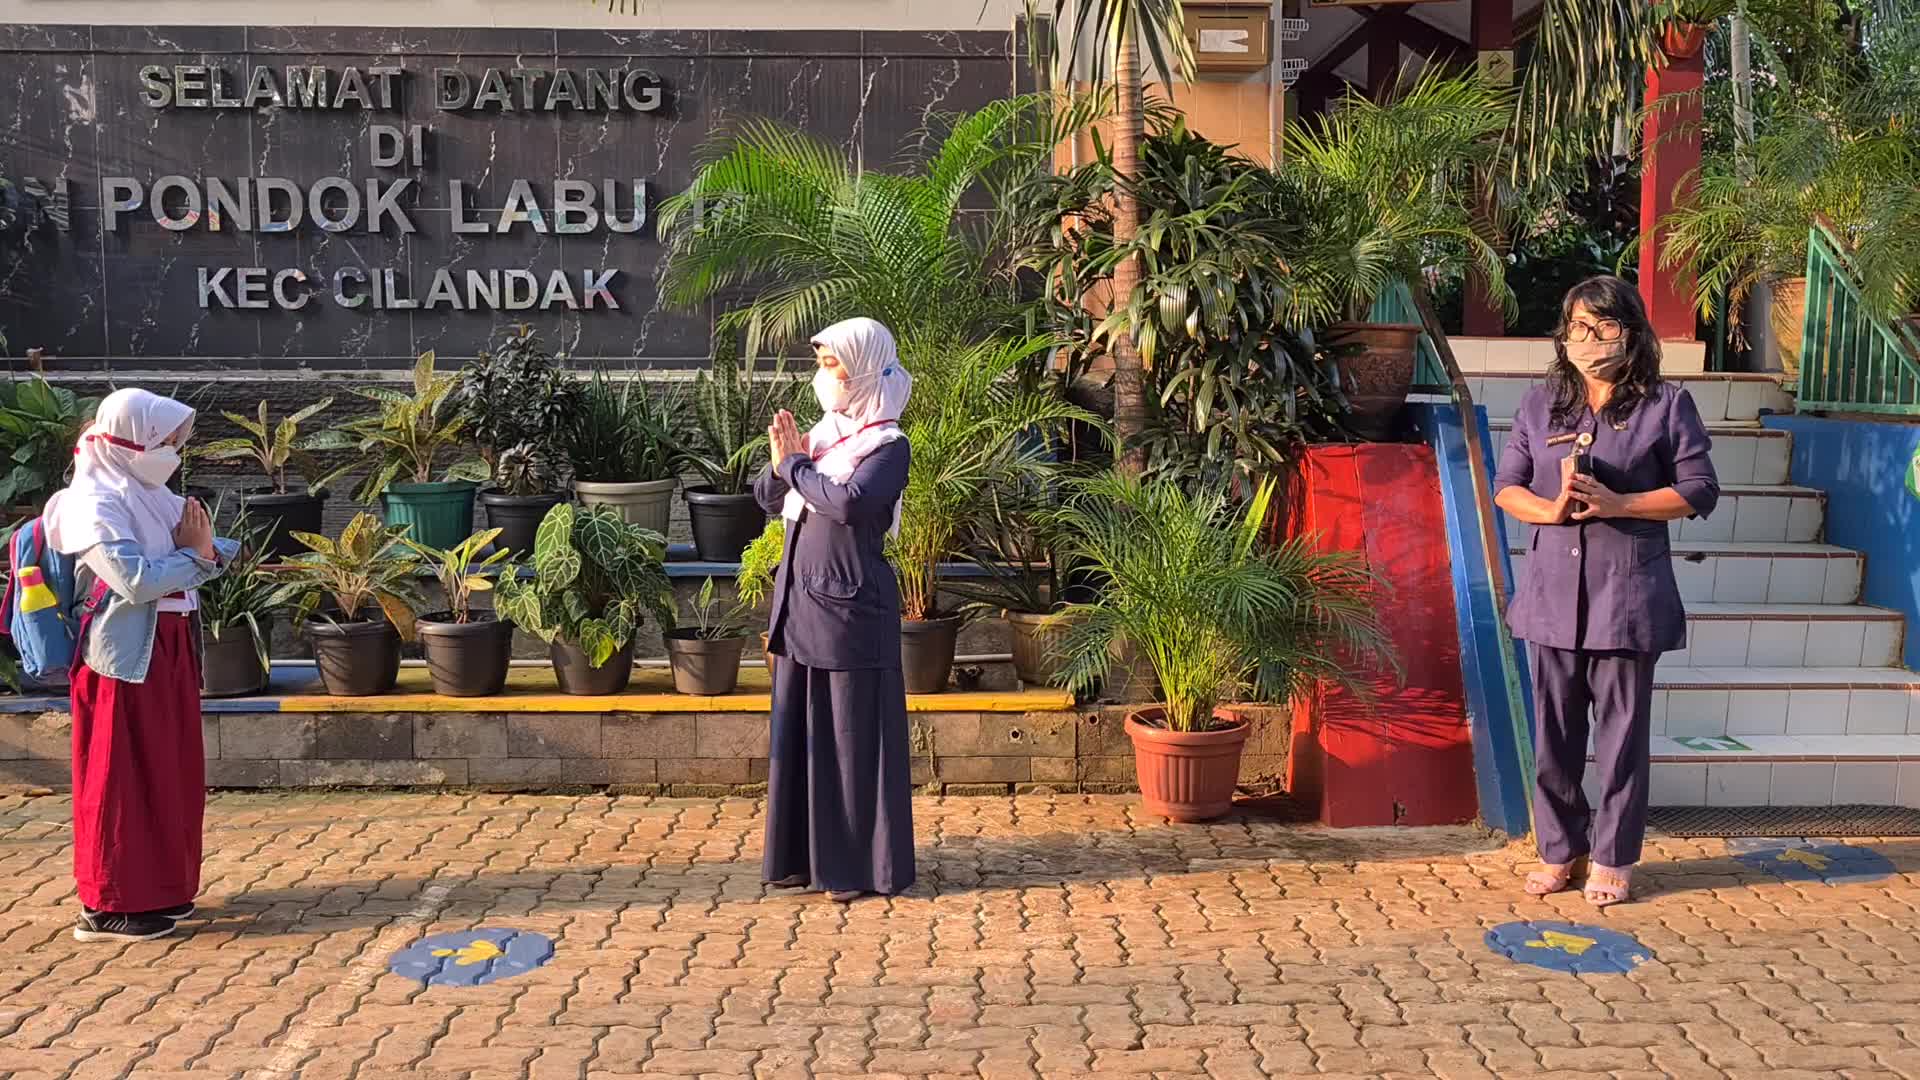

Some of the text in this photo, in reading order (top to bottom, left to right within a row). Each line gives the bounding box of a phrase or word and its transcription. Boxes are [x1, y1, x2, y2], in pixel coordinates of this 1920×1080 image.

[138, 65, 661, 111] SELAMAT DATANG
[370, 125, 423, 167] DI
[102, 175, 416, 233] PONDOK
[449, 178, 646, 234] LABU
[197, 266, 620, 310] KEC CILANDAK
